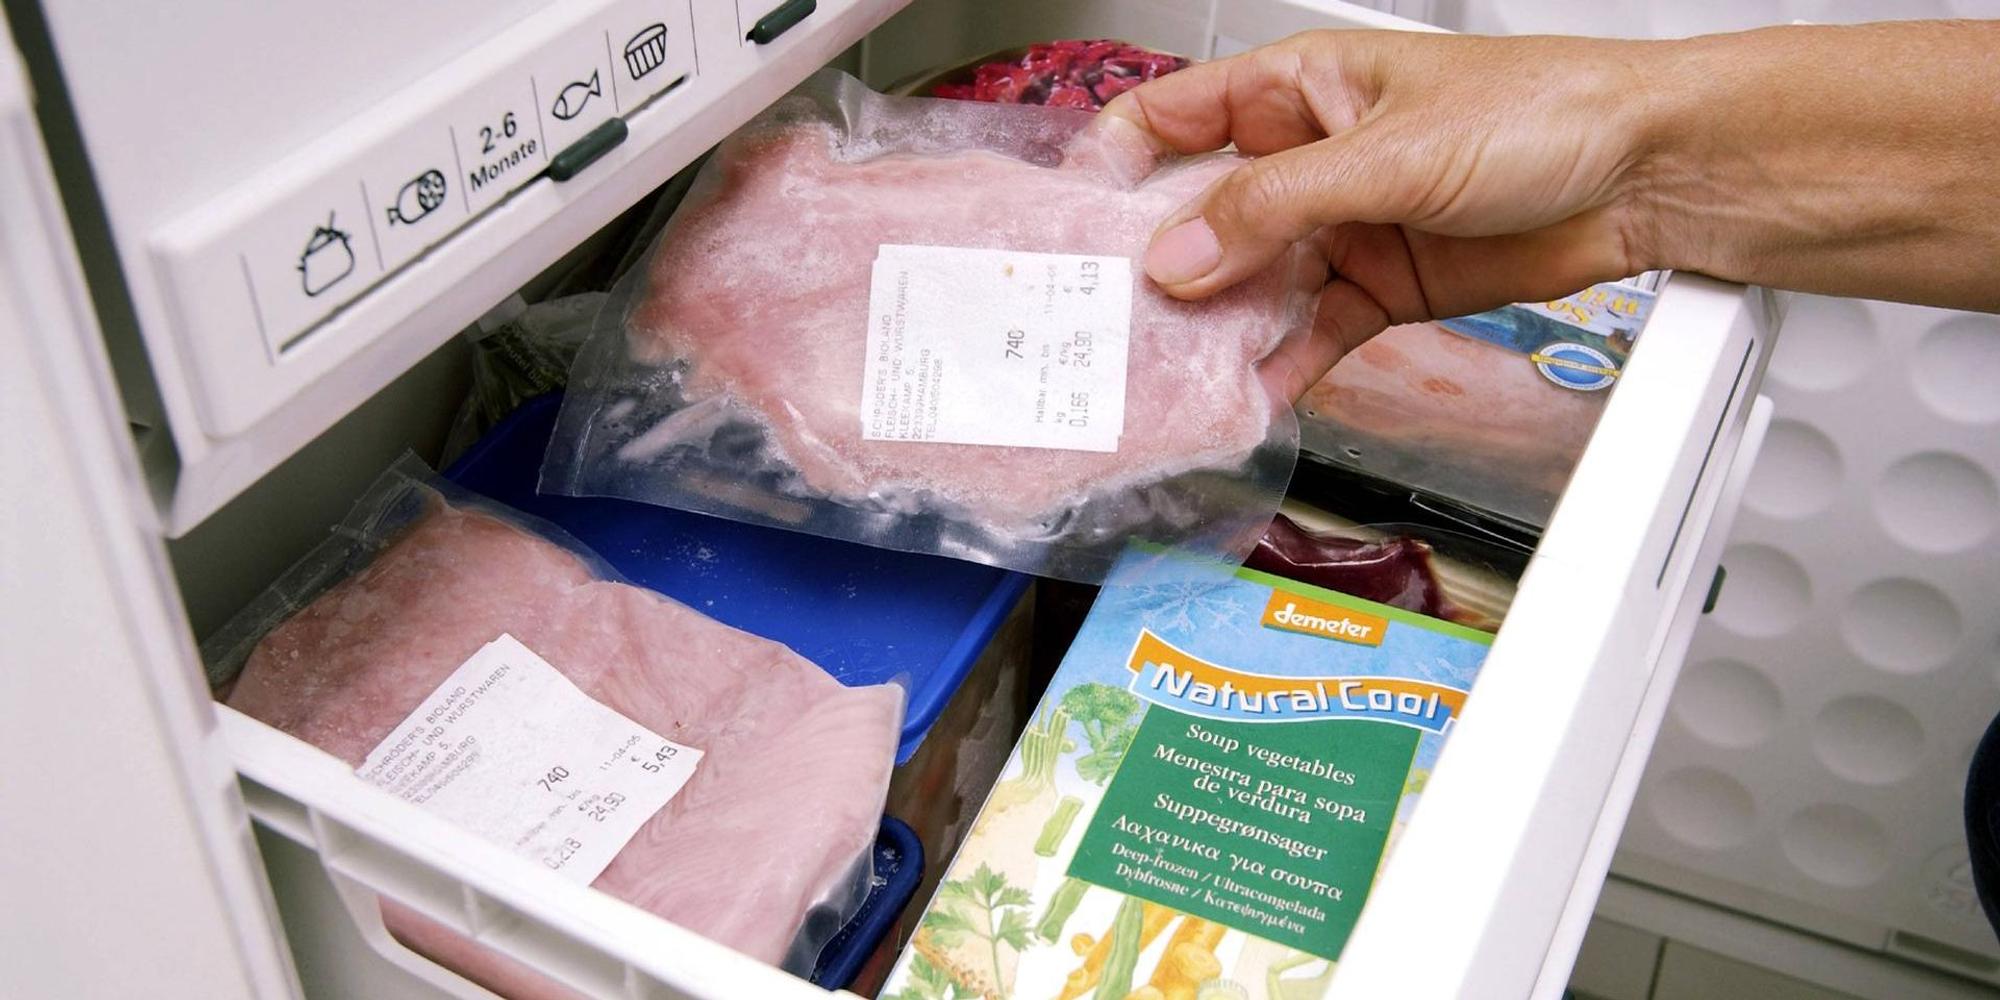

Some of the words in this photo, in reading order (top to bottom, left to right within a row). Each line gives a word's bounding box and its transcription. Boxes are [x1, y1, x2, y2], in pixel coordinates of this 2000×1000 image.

[480, 112, 517, 154] 2-6
[470, 139, 536, 191] Monate
[1079, 261, 1100, 296] 4,13
[1006, 329, 1025, 359] 740
[1073, 331, 1093, 368] 24,90
[893, 357, 903, 382] UND
[1069, 392, 1089, 428] 0,166
[1273, 603, 1373, 640] demeter
[422, 725, 445, 746] UND
[445, 663, 511, 725] WURSTWAREN
[425, 686, 467, 725] BIOLAND
[1150, 663, 1330, 714] Natural
[1339, 681, 1441, 719] Cool
[1186, 723, 1239, 753] Soup
[1247, 743, 1356, 786] vegetables
[537, 765, 570, 792] 740
[587, 791, 627, 823] 24,90
[641, 744, 679, 774] 5,43
[1154, 743, 1251, 788] Menestra
[1257, 777, 1308, 805] para
[1314, 796, 1367, 824] sopa
[1193, 774, 1221, 794] de
[1228, 786, 1312, 825] verdura
[1154, 793, 1329, 862] Suppegrønsager
[1112, 842, 1199, 881] Deep-frozen
[1213, 875, 1326, 922] Ultracongelada
[1115, 862, 1190, 896] Dybfrosne
